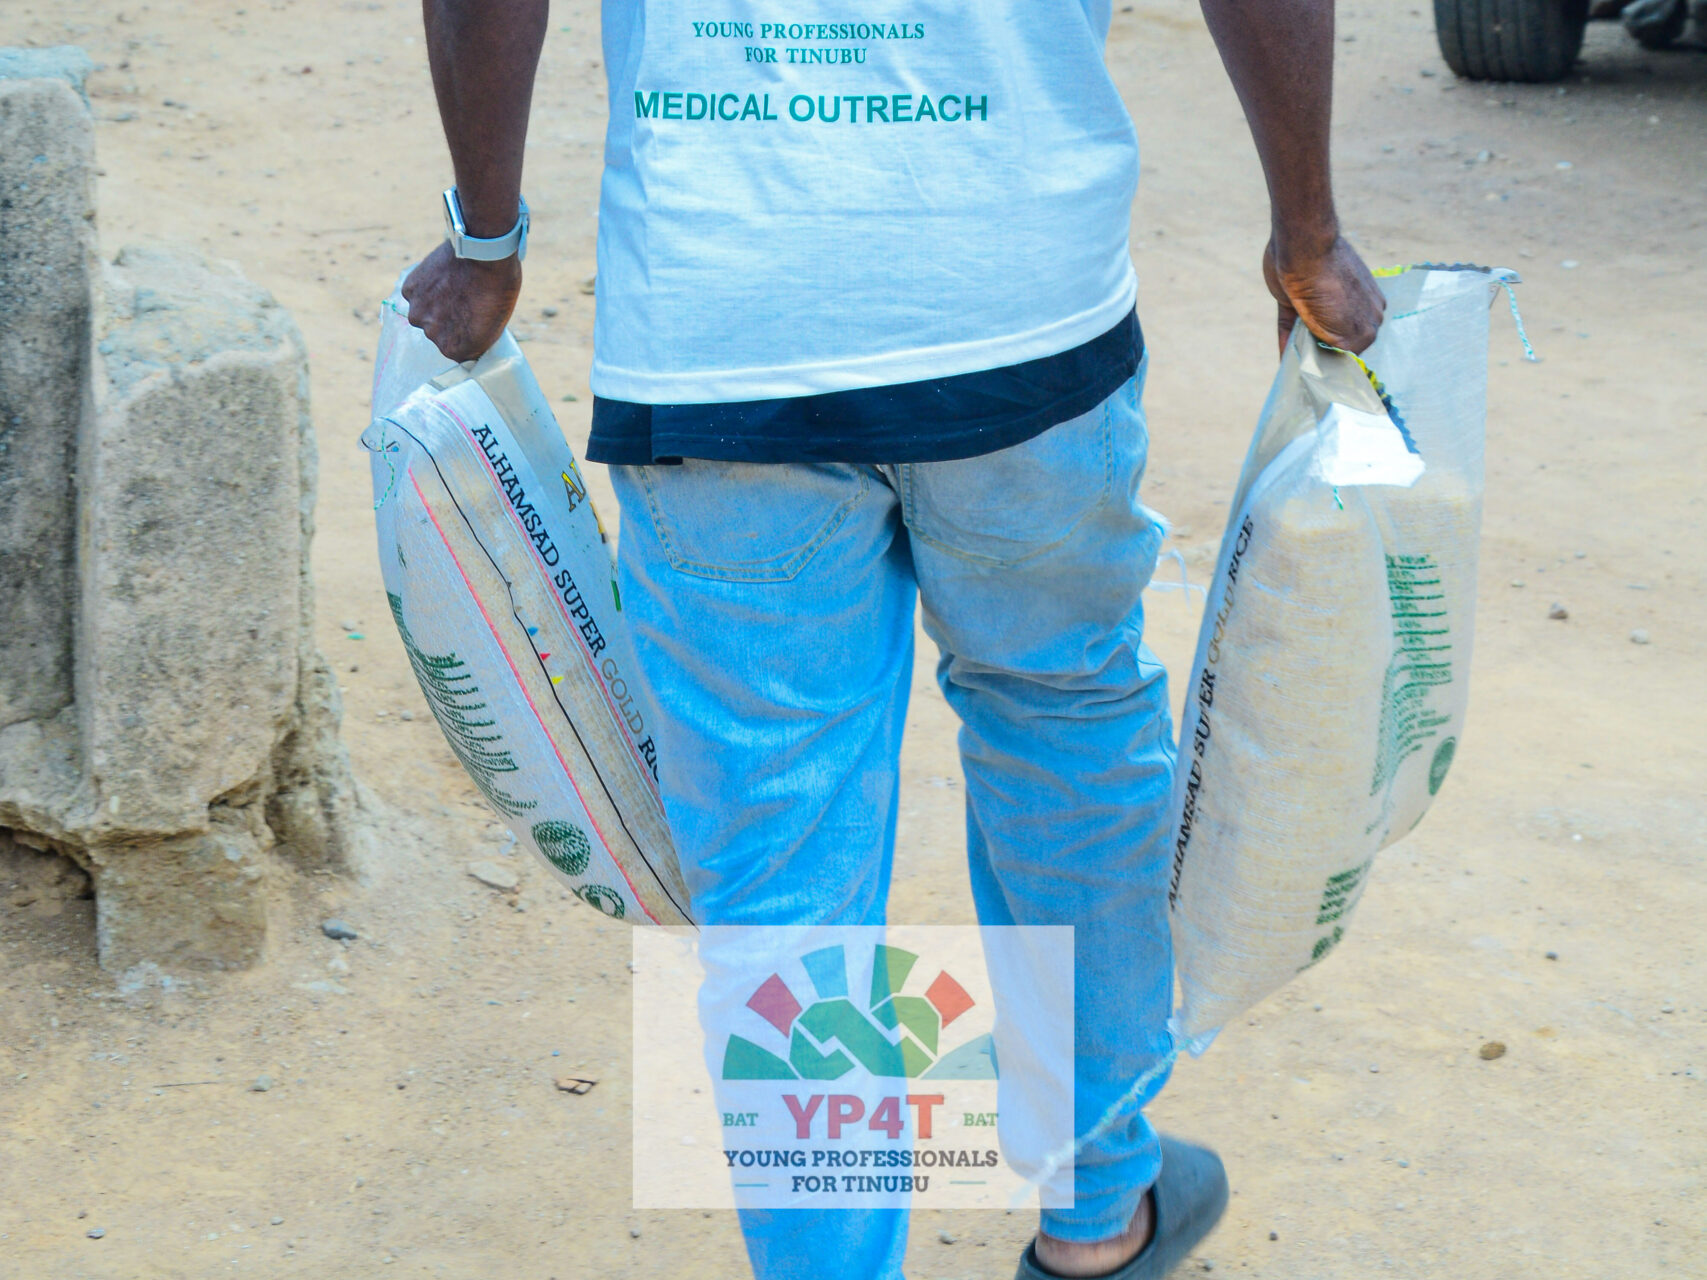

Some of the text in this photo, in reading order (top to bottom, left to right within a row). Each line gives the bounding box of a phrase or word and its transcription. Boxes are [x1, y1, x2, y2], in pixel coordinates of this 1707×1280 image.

[692, 22, 925, 41] YOUNG PROFESSIONALS
[745, 46, 867, 64] FOR TINUBU
[634, 90, 988, 123] MEDICAL OUTREACH
[472, 424, 659, 784] ALHAMSAD SUPER GOLD RI
[1168, 759, 1202, 913] ALHAMSAD
[1207, 585, 1235, 664] GOLD
[1228, 513, 1254, 586] RICE
